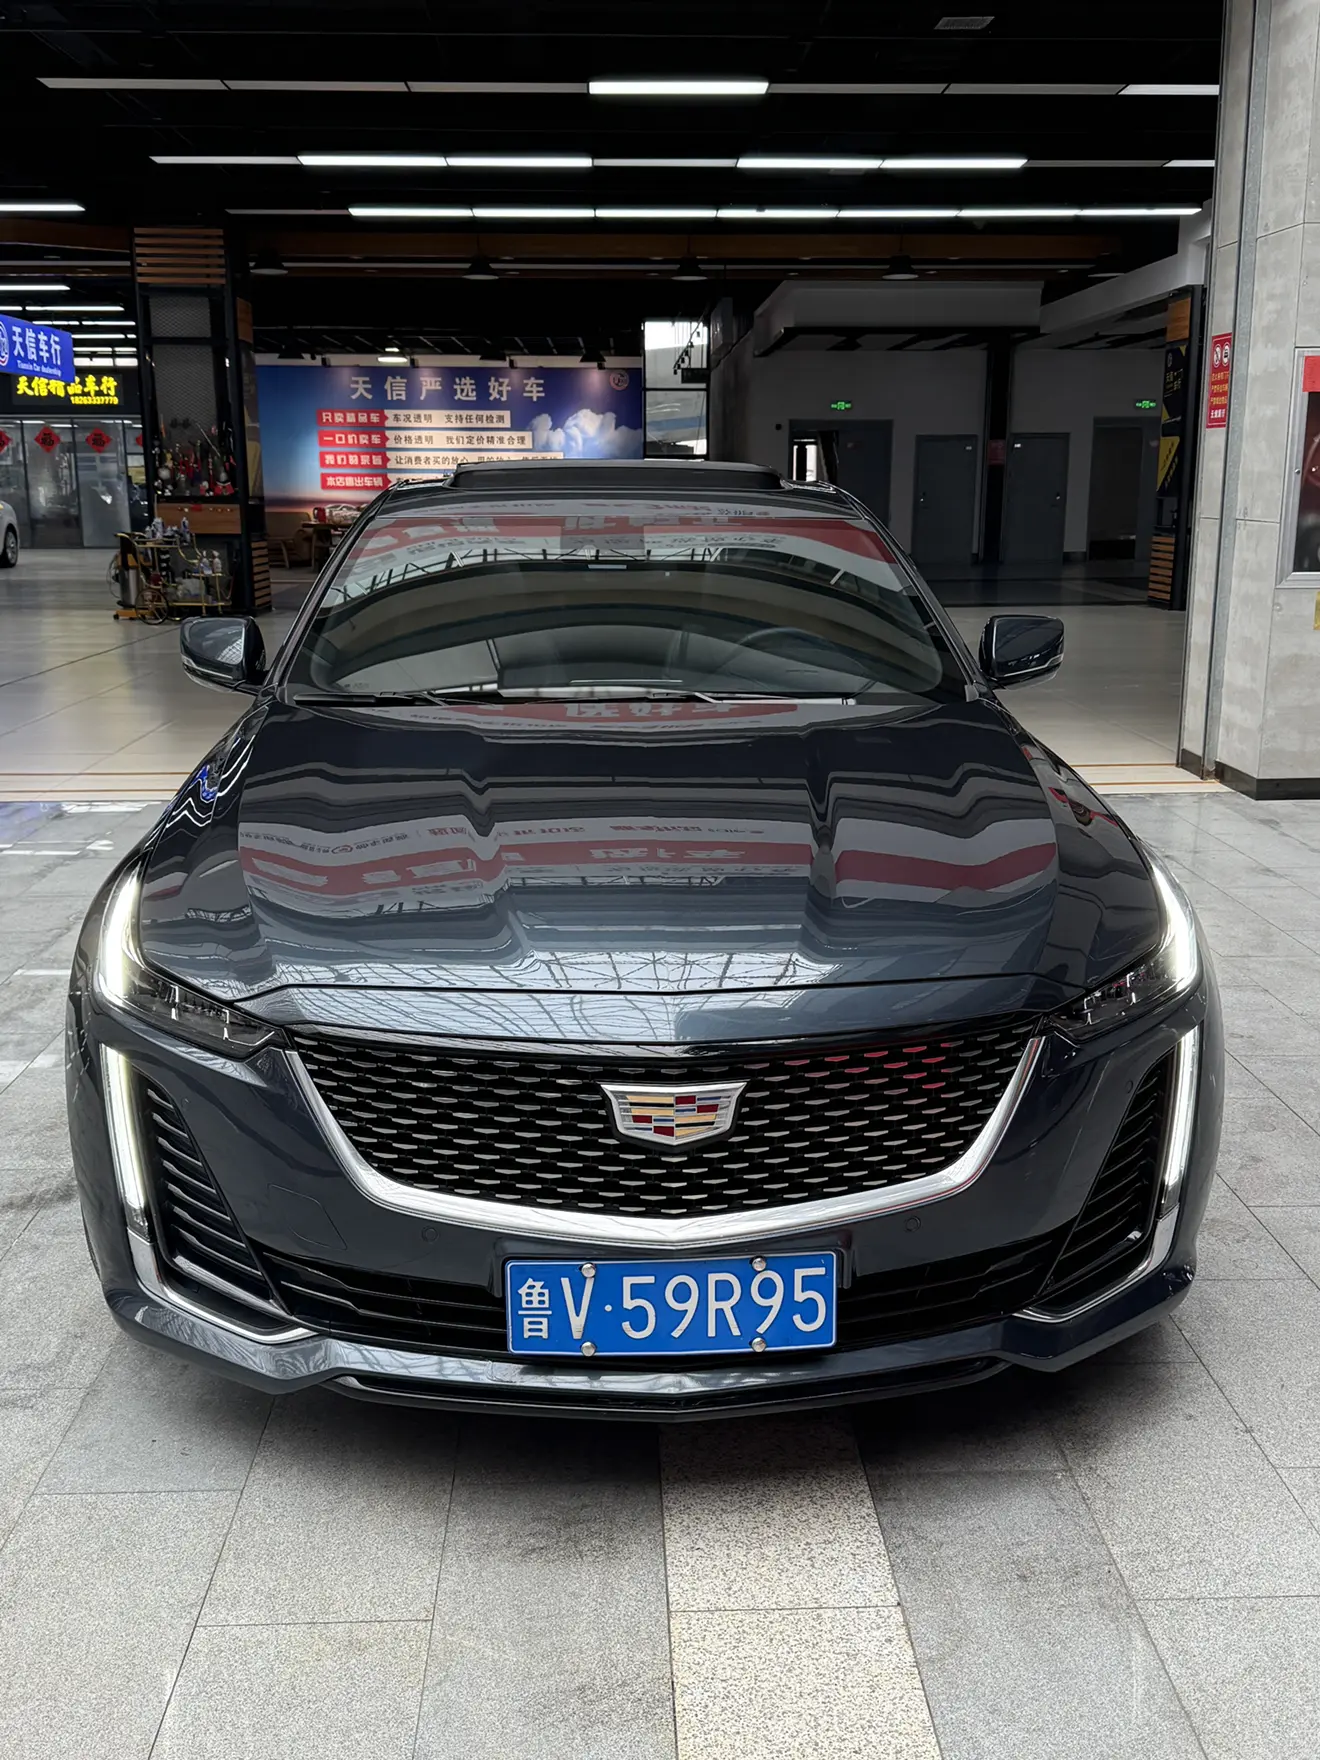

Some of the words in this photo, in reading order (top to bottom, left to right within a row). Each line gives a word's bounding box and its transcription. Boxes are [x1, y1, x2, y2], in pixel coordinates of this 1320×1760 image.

[12, 325, 61, 366] 天信车行
[350, 376, 545, 401] 天信严选好车
[322, 411, 380, 423] 只卖精品车
[392, 413, 433, 424] 车况透明
[444, 414, 505, 424] 支持任何检测
[393, 435, 434, 445] 价格透明
[445, 435, 526, 446] 我们定价精准合理
[517, 1266, 827, 1341] 鲁V·59R95
